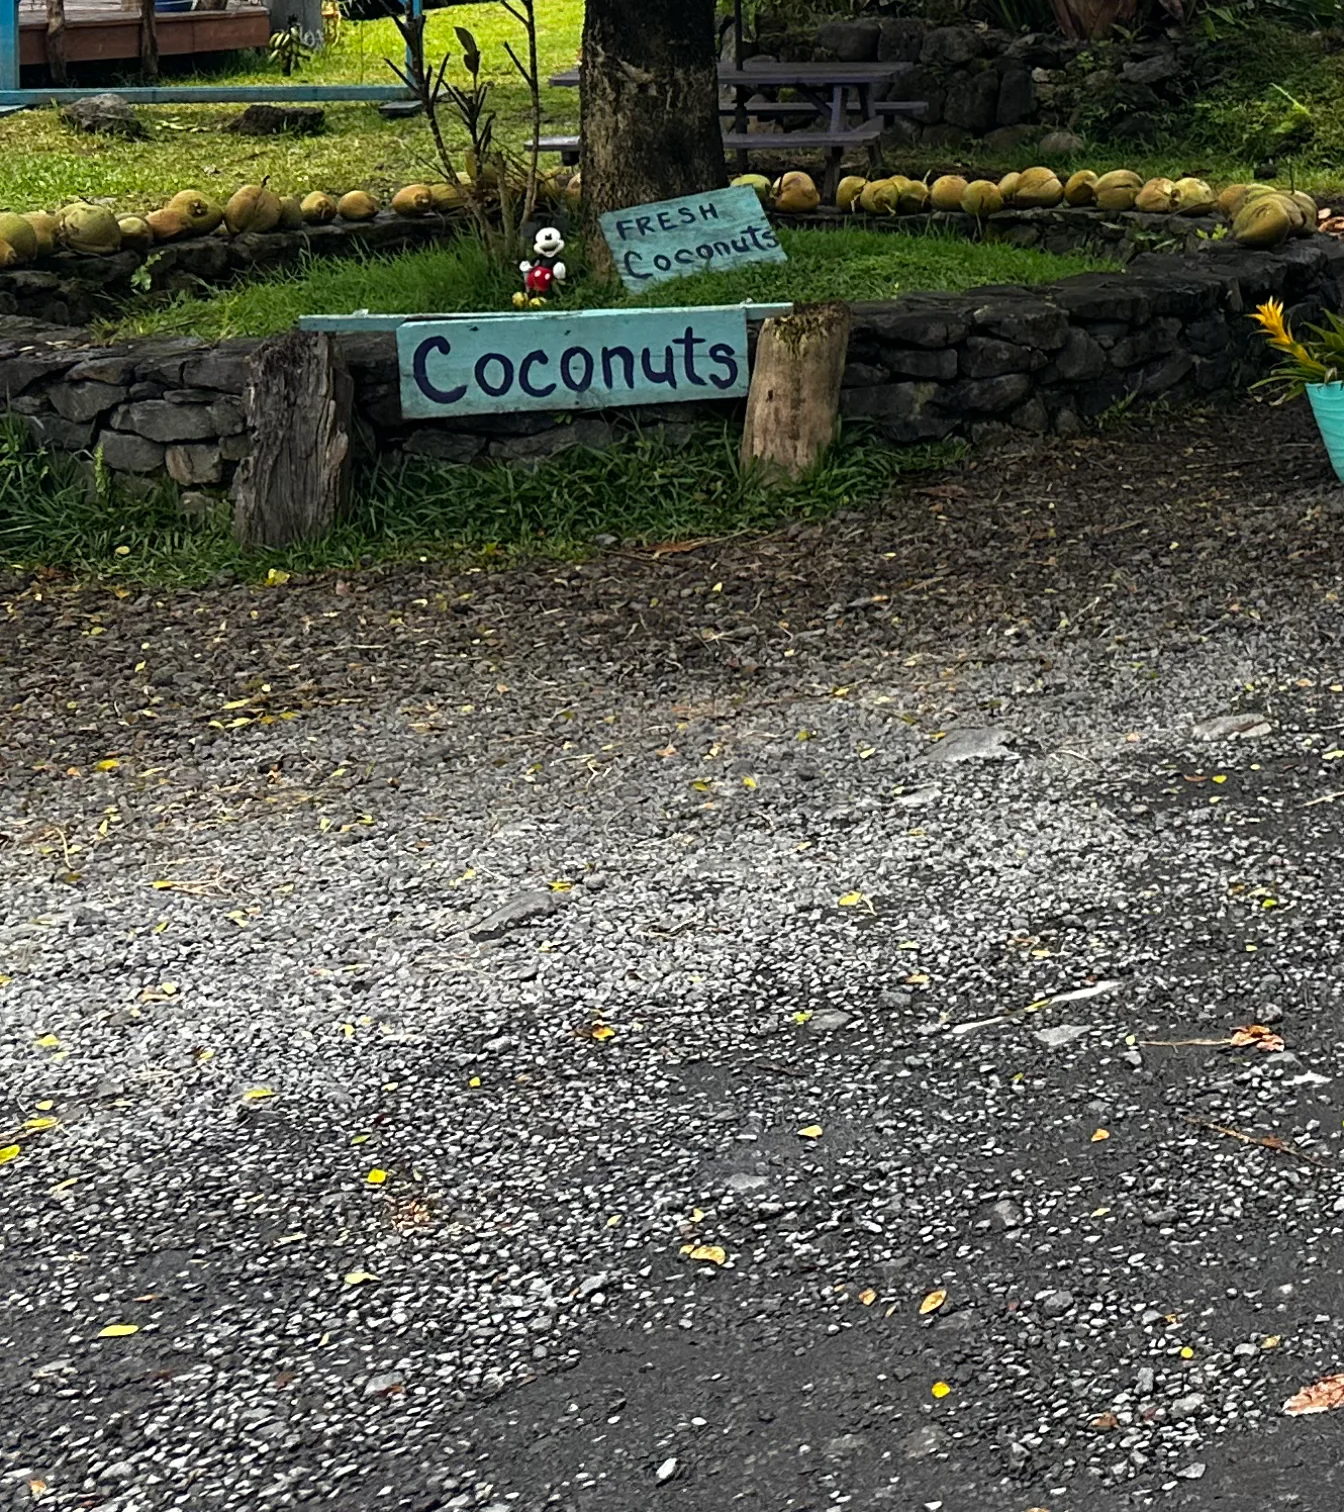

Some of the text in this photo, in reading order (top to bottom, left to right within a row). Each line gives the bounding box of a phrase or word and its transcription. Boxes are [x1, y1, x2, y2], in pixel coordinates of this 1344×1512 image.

[616, 201, 720, 243] FRESH
[623, 225, 781, 280] Coconuts
[412, 326, 739, 404] Coconuts
